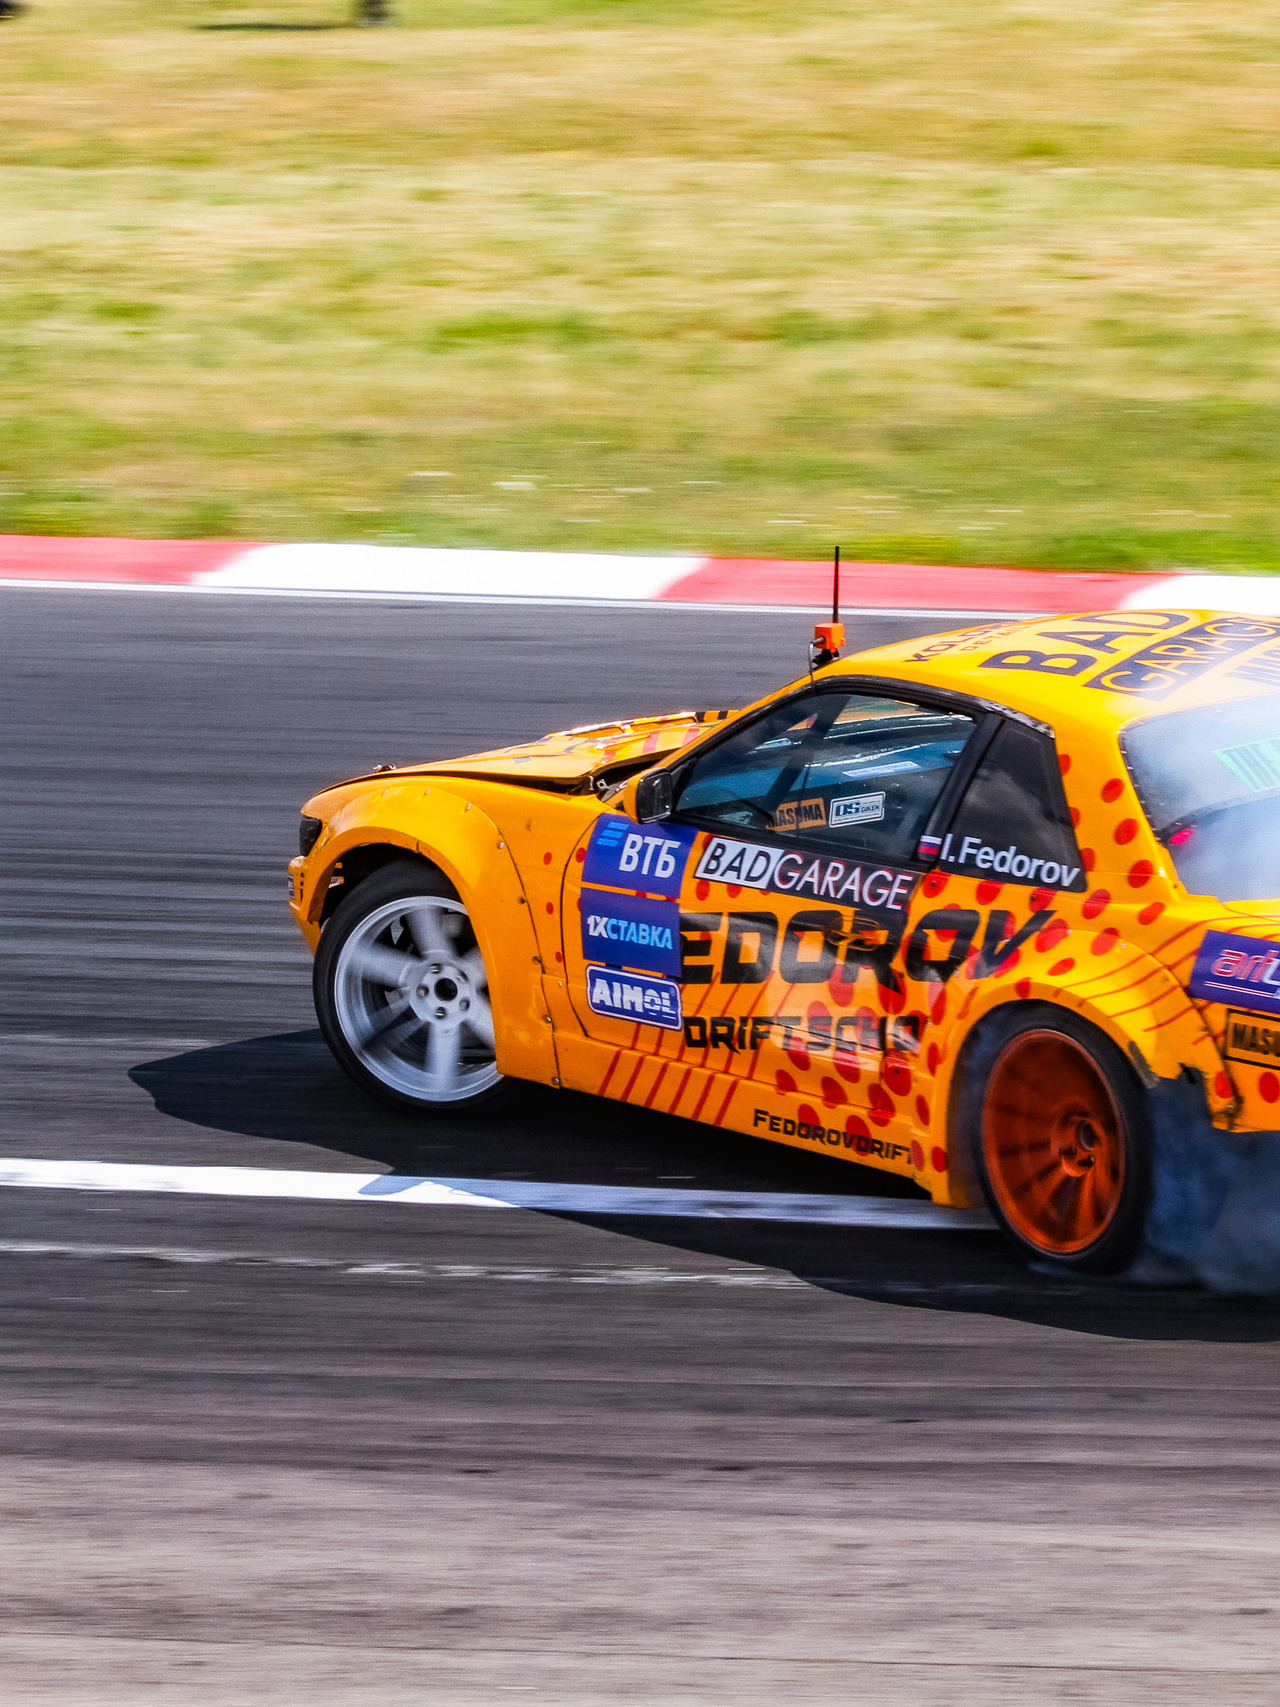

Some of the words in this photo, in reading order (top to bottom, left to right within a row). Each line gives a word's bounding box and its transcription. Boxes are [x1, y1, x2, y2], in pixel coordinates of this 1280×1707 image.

[978, 611, 1191, 677] BAD
[836, 801, 860, 817] OS
[619, 833, 681, 879] ВТБ
[679, 908, 1058, 997] EDOROV
